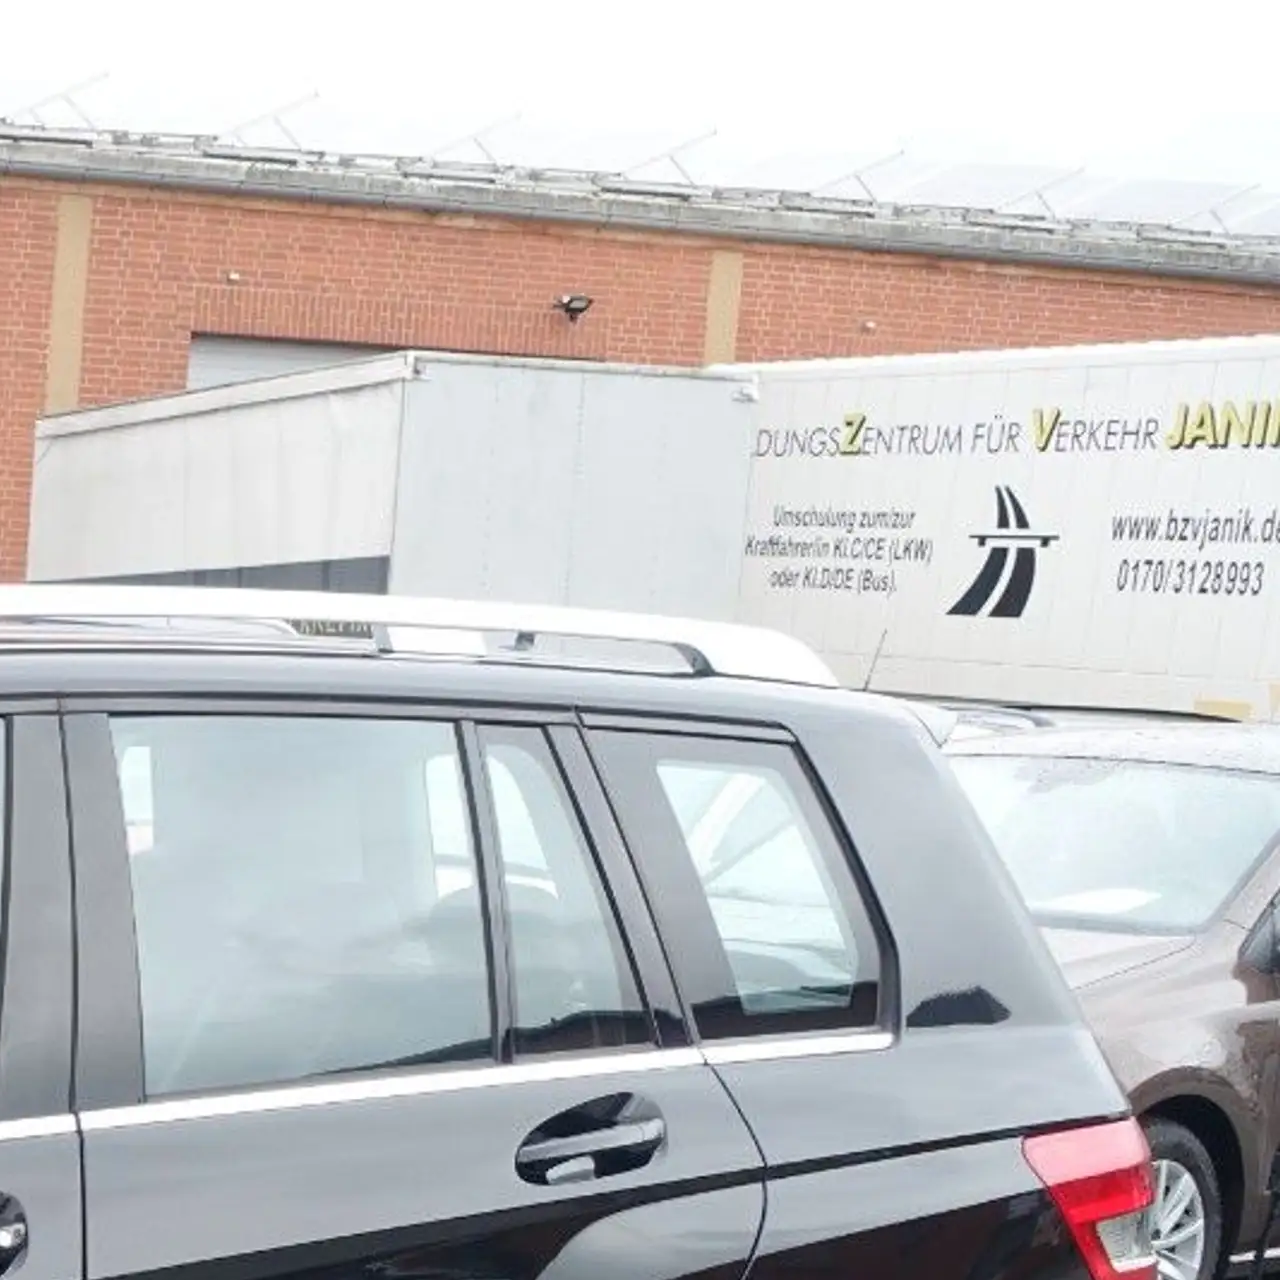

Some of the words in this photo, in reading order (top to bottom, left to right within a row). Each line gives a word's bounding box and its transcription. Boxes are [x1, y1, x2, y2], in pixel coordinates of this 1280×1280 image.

[970, 414, 1022, 454] FÜR
[1032, 406, 1159, 453] VERKEHR
[1166, 400, 1280, 452] JANI
[772, 504, 856, 533] Umschulung
[888, 538, 934, 567] (LKW)
[769, 568, 799, 588] oder
[1116, 559, 1265, 596] 0170/3128993
